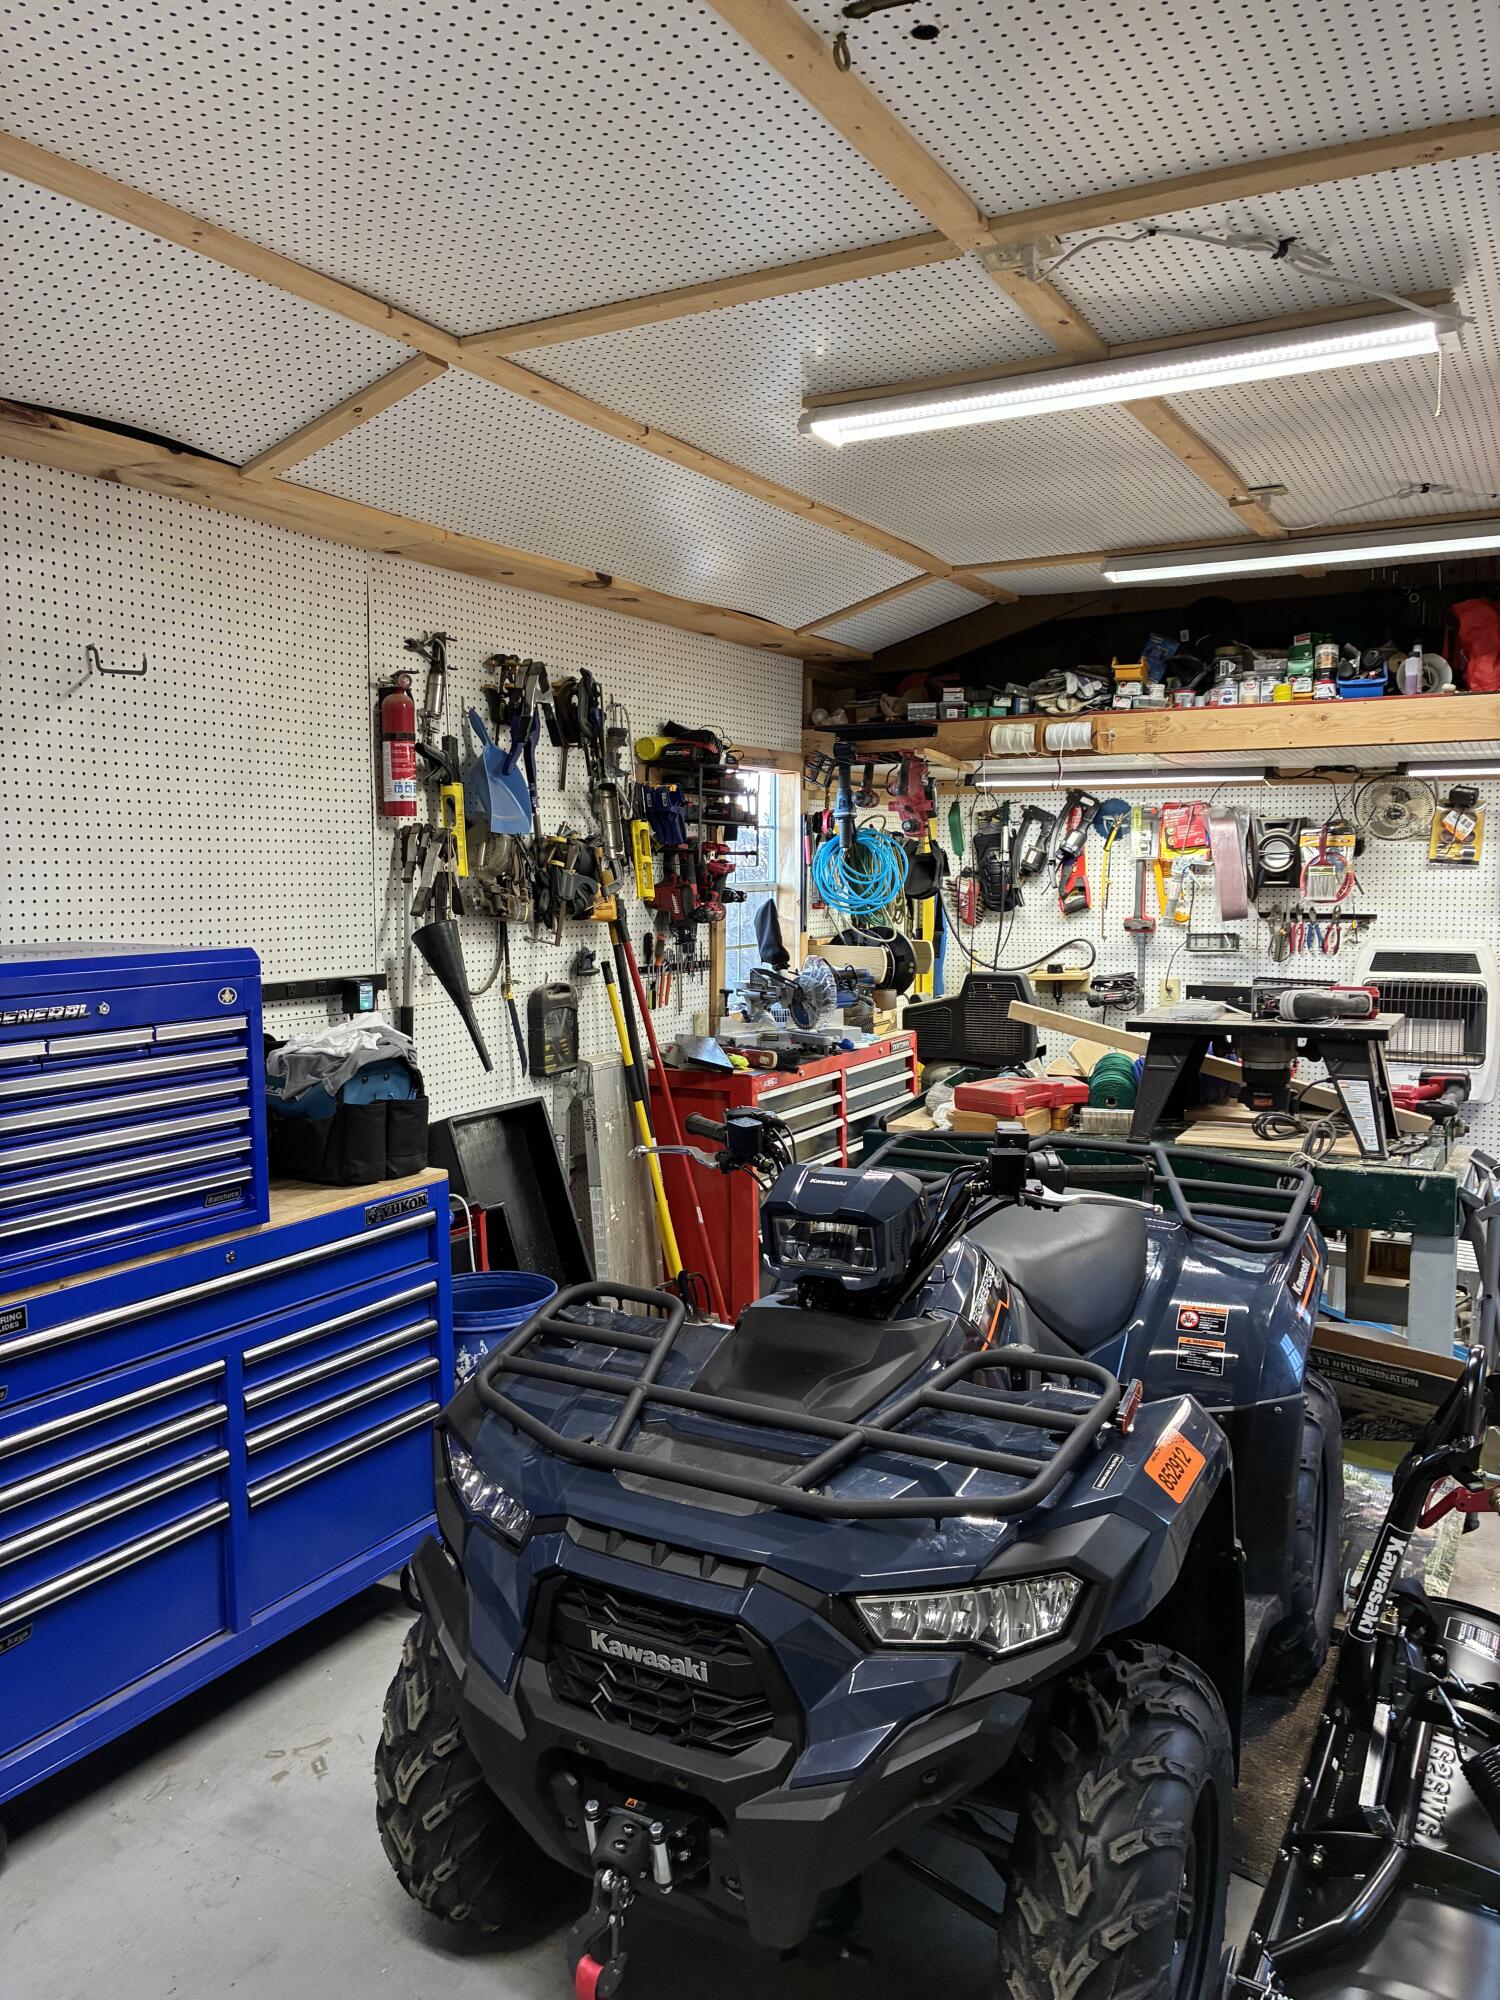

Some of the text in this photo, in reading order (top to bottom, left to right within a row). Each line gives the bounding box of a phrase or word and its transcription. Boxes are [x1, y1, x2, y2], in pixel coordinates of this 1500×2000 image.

[0, 1004, 91, 1024] ENERAL
[809, 1178, 848, 1187] Kawasaki
[381, 1194, 427, 1218] YUKON
[1291, 1255, 1310, 1295] Kawasaki
[0, 1320, 20, 1333] IDES
[1158, 1446, 1192, 1491] 852912
[1357, 1536, 1407, 1635] Kawasaki
[590, 1629, 708, 1682] Kawasaki
